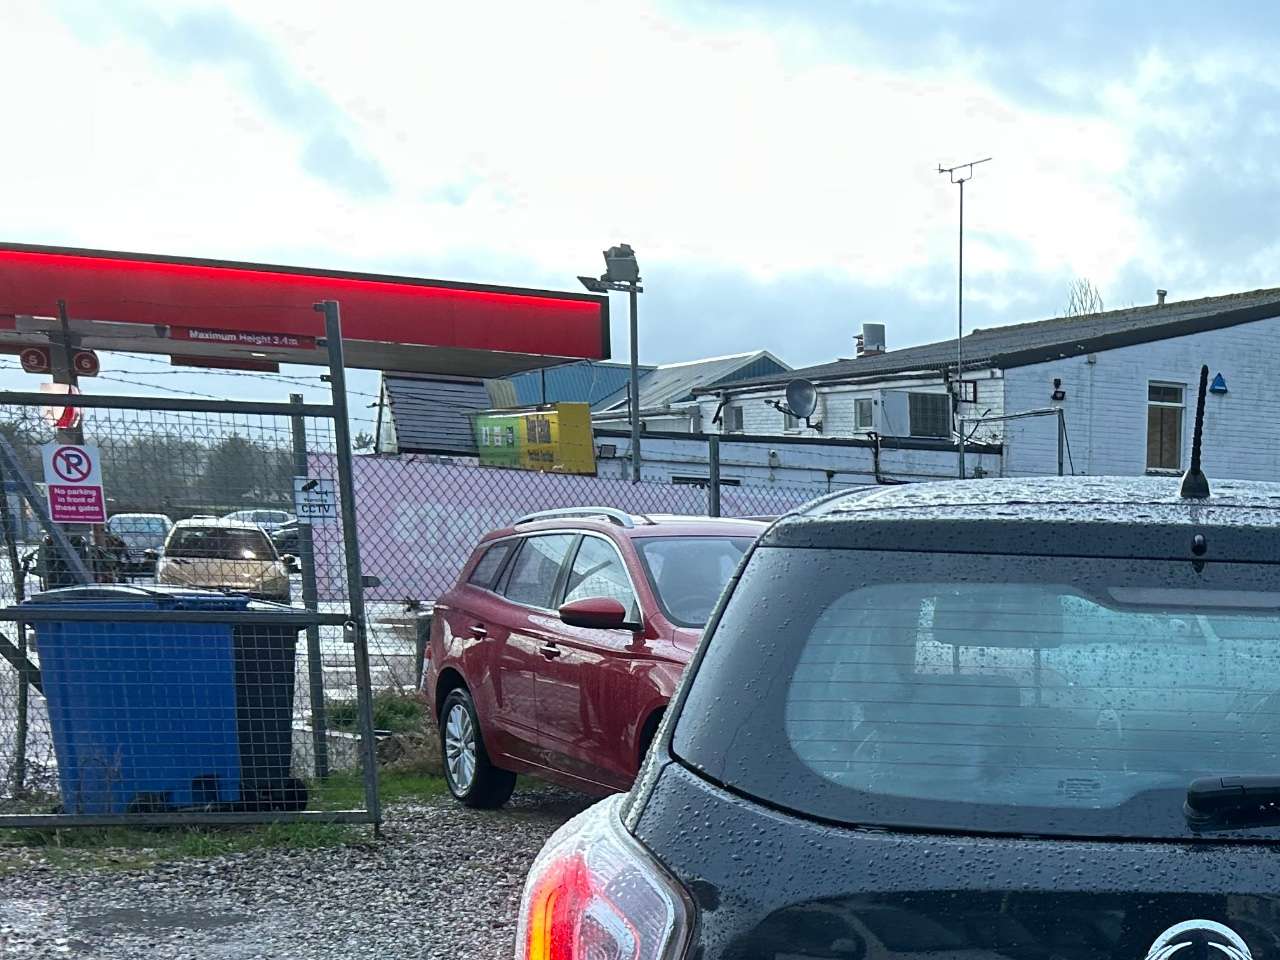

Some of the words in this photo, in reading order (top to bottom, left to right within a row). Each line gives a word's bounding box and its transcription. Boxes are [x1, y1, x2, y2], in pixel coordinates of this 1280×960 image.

[189, 330, 236, 341] Maximum
[240, 334, 271, 345] Height
[67, 489, 97, 497] parking
[302, 504, 330, 513] CCTV
